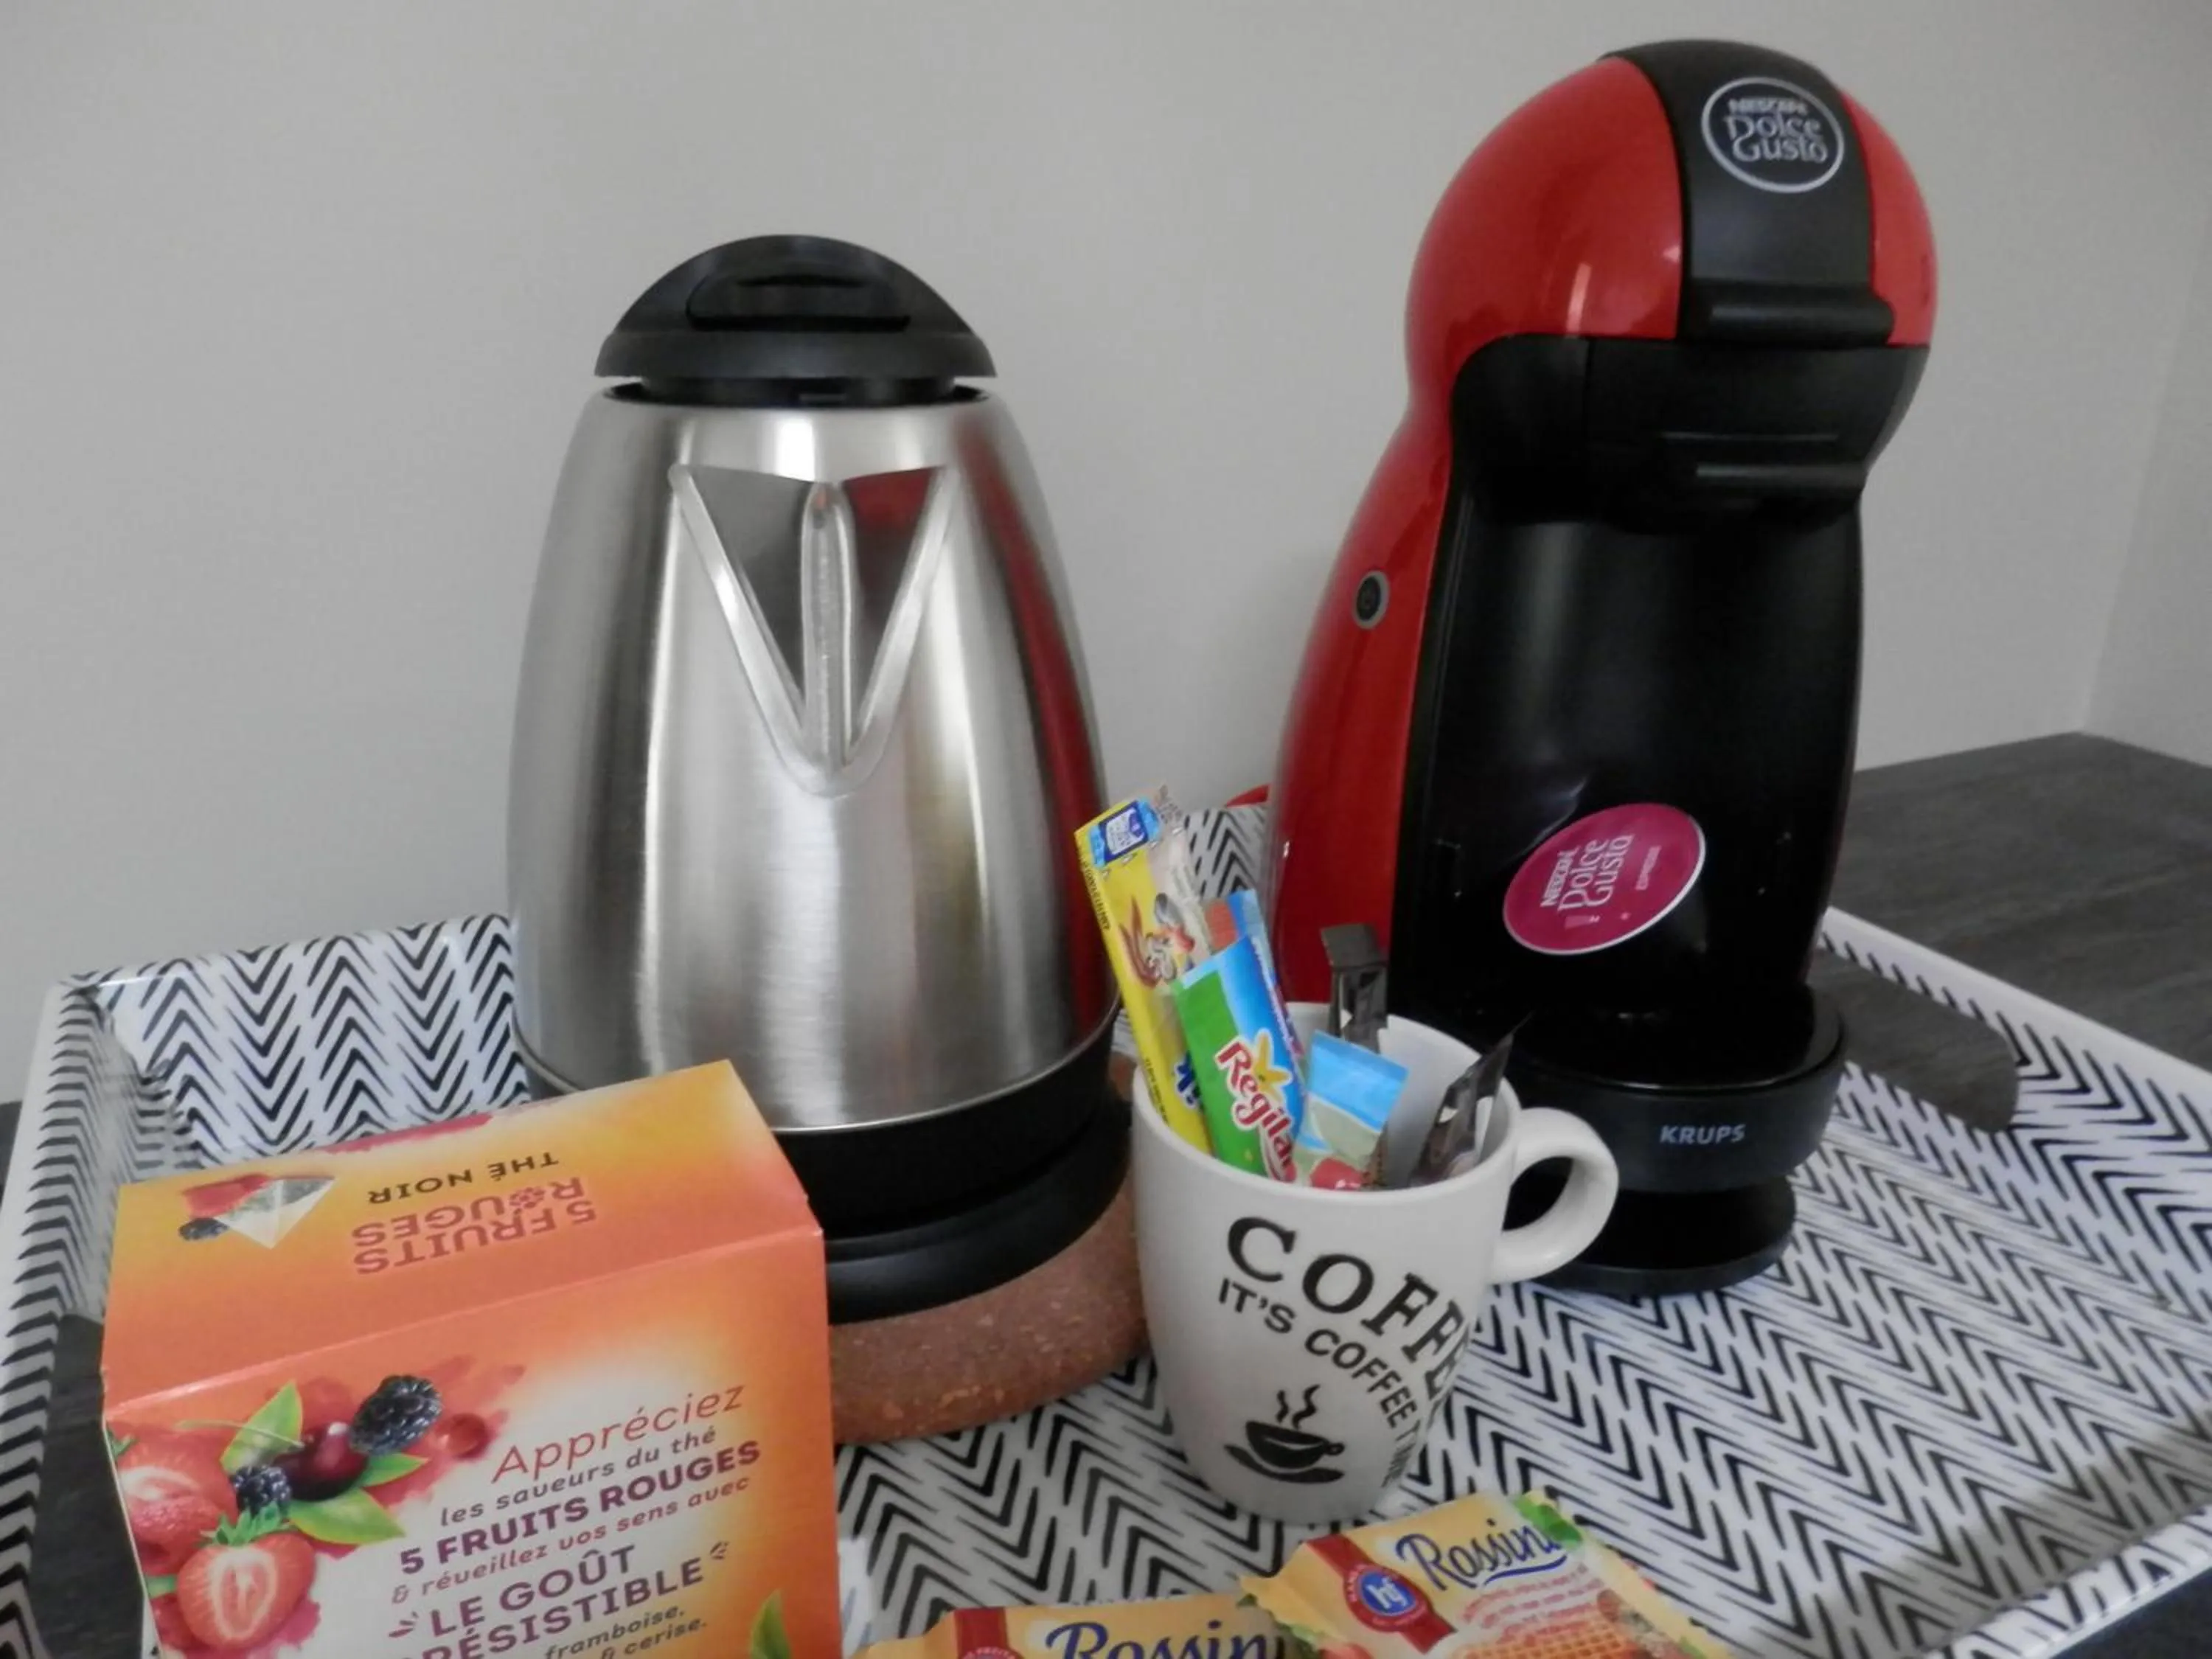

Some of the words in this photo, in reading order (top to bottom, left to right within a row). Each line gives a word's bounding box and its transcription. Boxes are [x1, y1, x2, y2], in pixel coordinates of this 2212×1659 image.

[1722, 112, 1823, 142] Dolce
[1733, 135, 1828, 163] Gusto
[1557, 839, 1609, 911] Dolce
[1583, 834, 1636, 907] Gusto
[487, 1152, 559, 1182] THÉ
[1660, 1123, 1746, 1144] KRUPS
[367, 1169, 473, 1205] NOIR
[566, 1200, 596, 1226] 5
[353, 1207, 555, 1275] FRUITS
[1218, 1278, 1296, 1335] IT'S
[1304, 1329, 1418, 1429] COFFEE
[1227, 1217, 1470, 1429] COFFE
[491, 1385, 745, 1484] Appréciez
[400, 1548, 425, 1575] 5
[436, 1495, 589, 1564] FRUITS
[599, 1440, 761, 1512] ROUGES
[441, 1503, 484, 1527] les
[496, 1460, 615, 1510] saveurs
[626, 1447, 660, 1469] du
[672, 1426, 716, 1454] thé
[392, 1584, 409, 1604] &
[421, 1544, 549, 1597] réveillez
[559, 1526, 607, 1551] vos
[616, 1503, 678, 1532] sens
[688, 1477, 749, 1507] avec
[430, 1596, 485, 1638] LE
[499, 1545, 636, 1612] GOÛT
